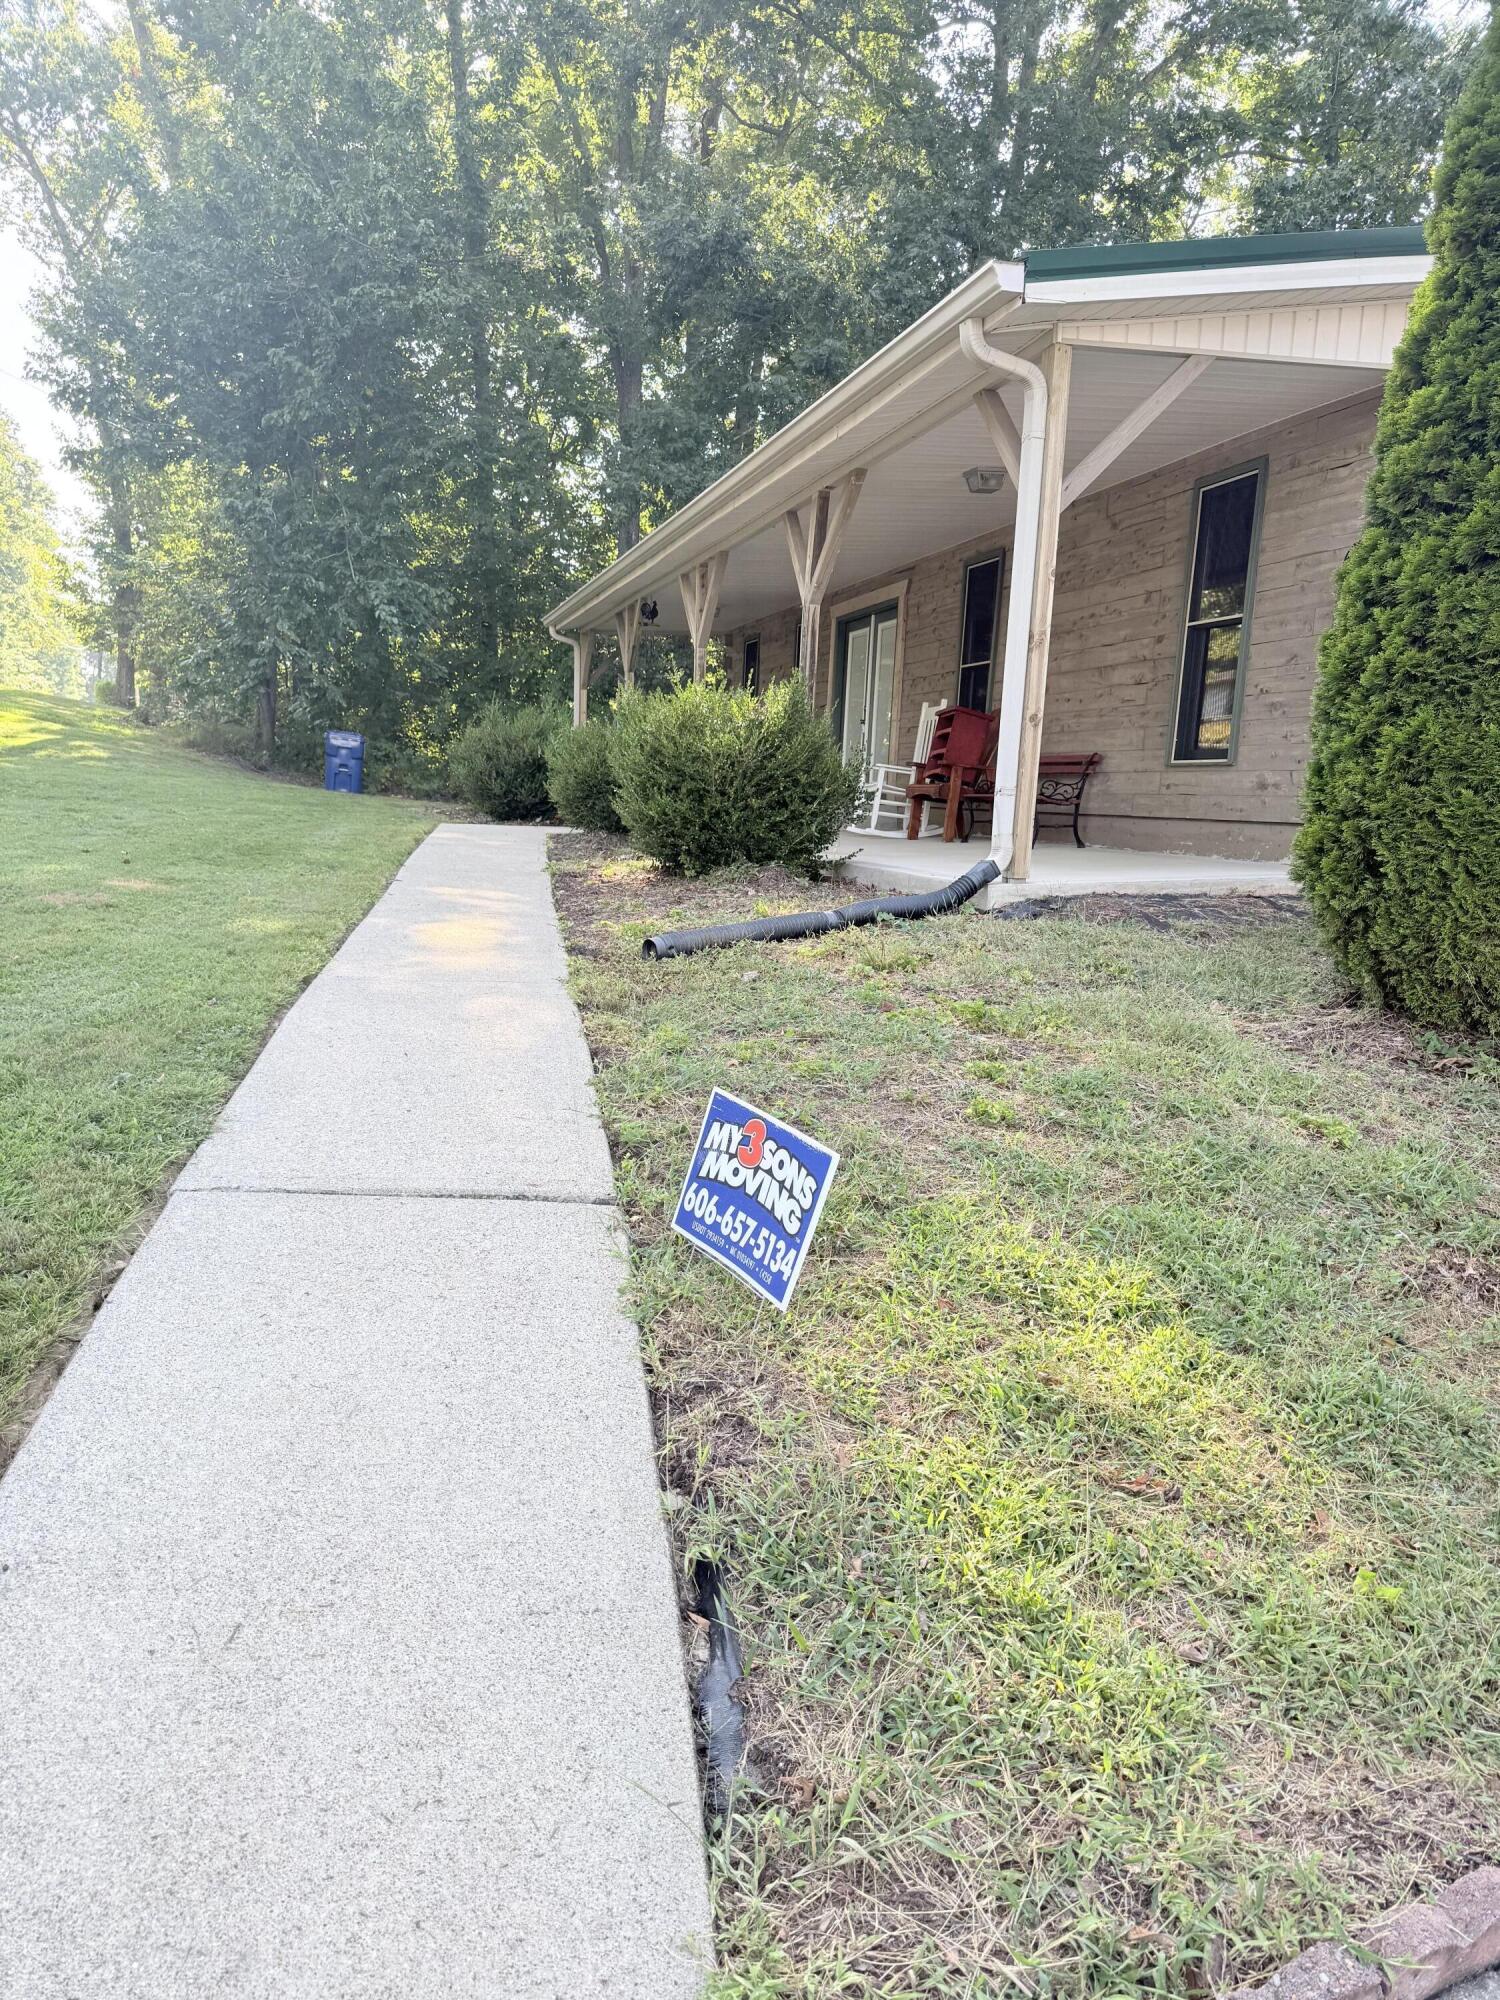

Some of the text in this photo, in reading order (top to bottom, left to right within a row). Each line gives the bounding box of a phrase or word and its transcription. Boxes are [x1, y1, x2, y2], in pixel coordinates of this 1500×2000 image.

[699, 1151, 802, 1236] MOVING
[703, 1118, 817, 1210] MY 3 SONS
[683, 1182, 797, 1282] 606-657-5134
